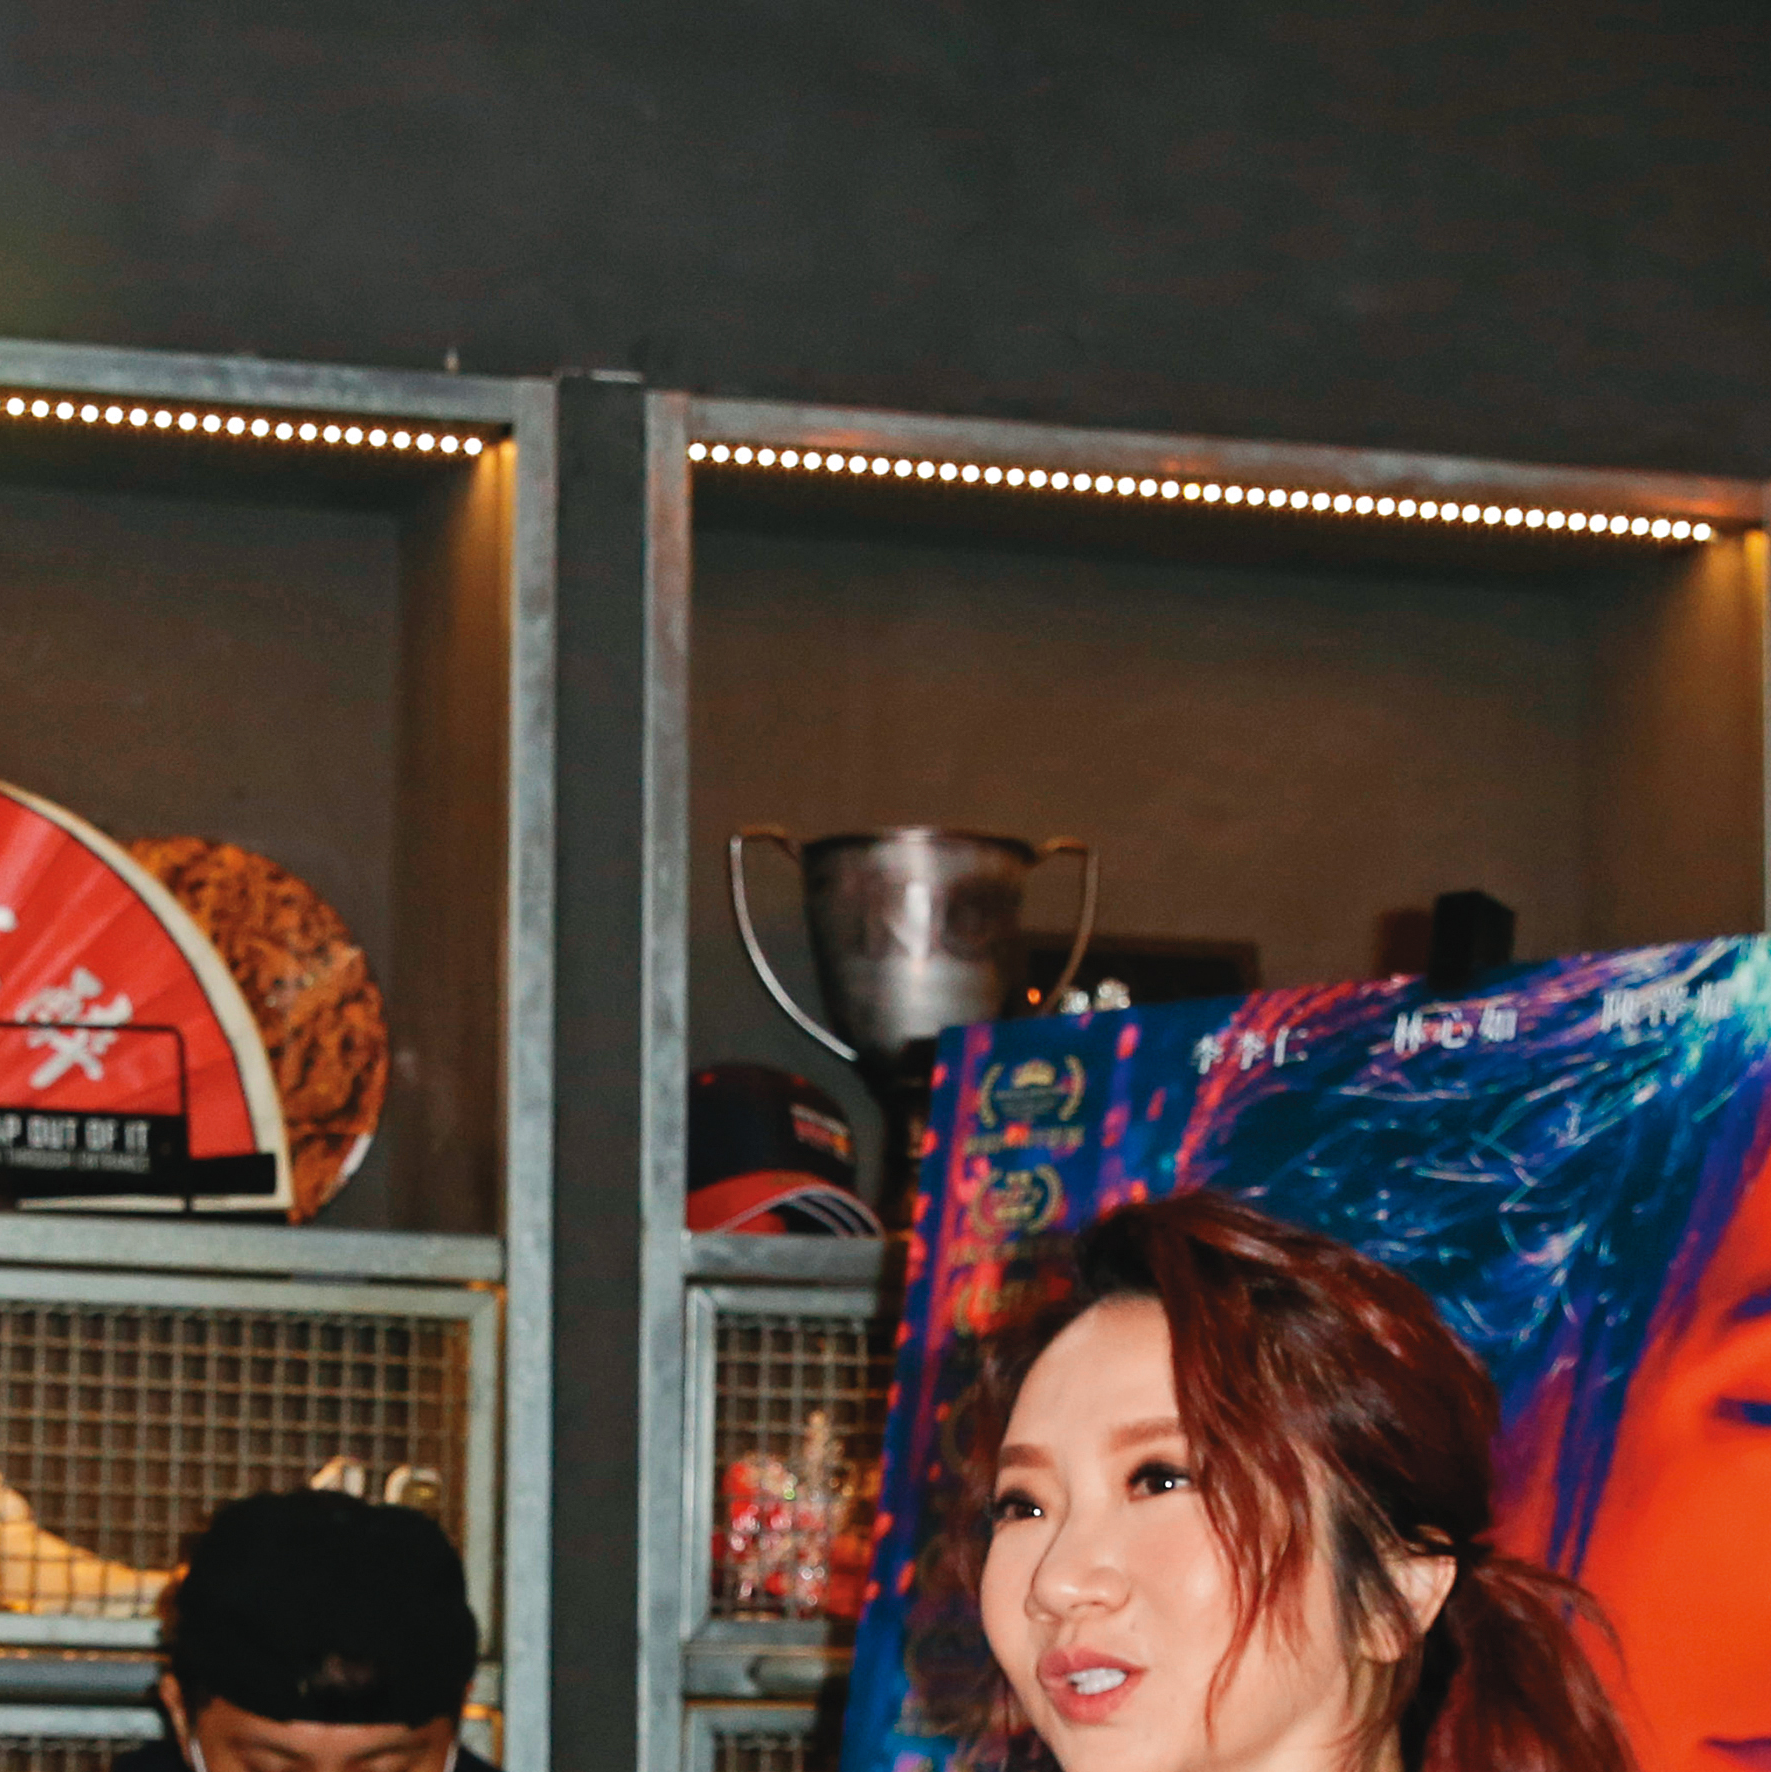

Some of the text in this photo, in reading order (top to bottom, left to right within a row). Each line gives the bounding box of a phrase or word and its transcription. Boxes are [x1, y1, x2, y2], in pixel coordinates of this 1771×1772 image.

[27, 1114, 78, 1149] OUT
[85, 1117, 119, 1151] OF
[124, 1119, 151, 1154] IT
